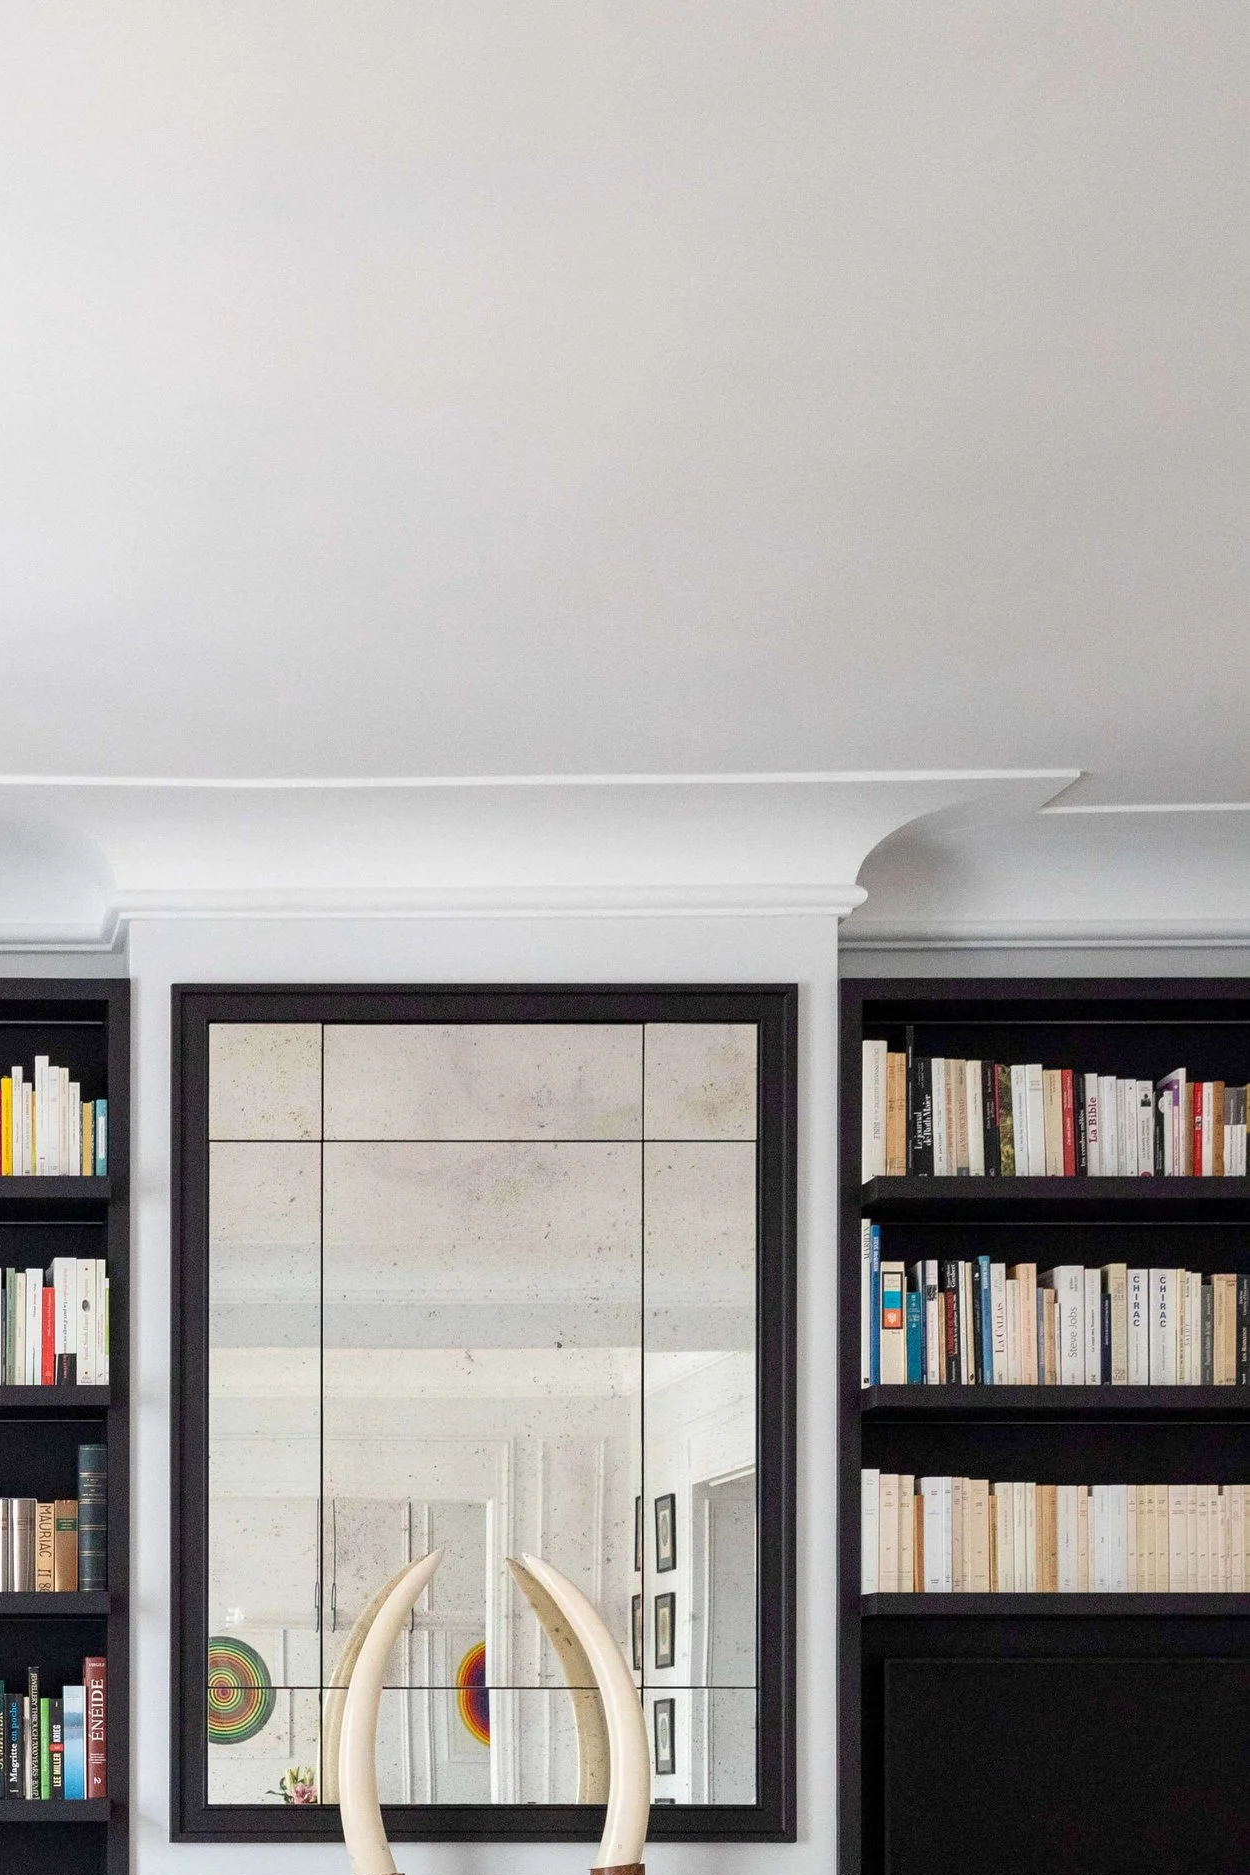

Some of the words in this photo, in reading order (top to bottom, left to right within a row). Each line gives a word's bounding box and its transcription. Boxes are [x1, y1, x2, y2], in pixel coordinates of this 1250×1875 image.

[1087, 1096, 1097, 1125] Bible
[1089, 1129, 1098, 1143] La
[863, 1225, 871, 1260] MARILYN
[1159, 1276, 1167, 1328] CHIRAC
[994, 1302, 1004, 1338] CALLAS
[1068, 1306, 1078, 1330] Jobs
[1068, 1331, 1078, 1358] Steve
[38, 1505, 52, 1558] MAURIAC
[37, 1569, 51, 1578] II
[9, 1702, 19, 1729] poche
[31, 1707, 39, 1740] THROUGH
[88, 1679, 105, 1743] ÉNÉIDE
[11, 1732, 17, 1742] en
[52, 1724, 62, 1743] KRIEG
[9, 1743, 19, 1783] Magritte
[53, 1752, 62, 1775] MILLER
[53, 1776, 62, 1787] LEE
[94, 1776, 101, 1785] 2
